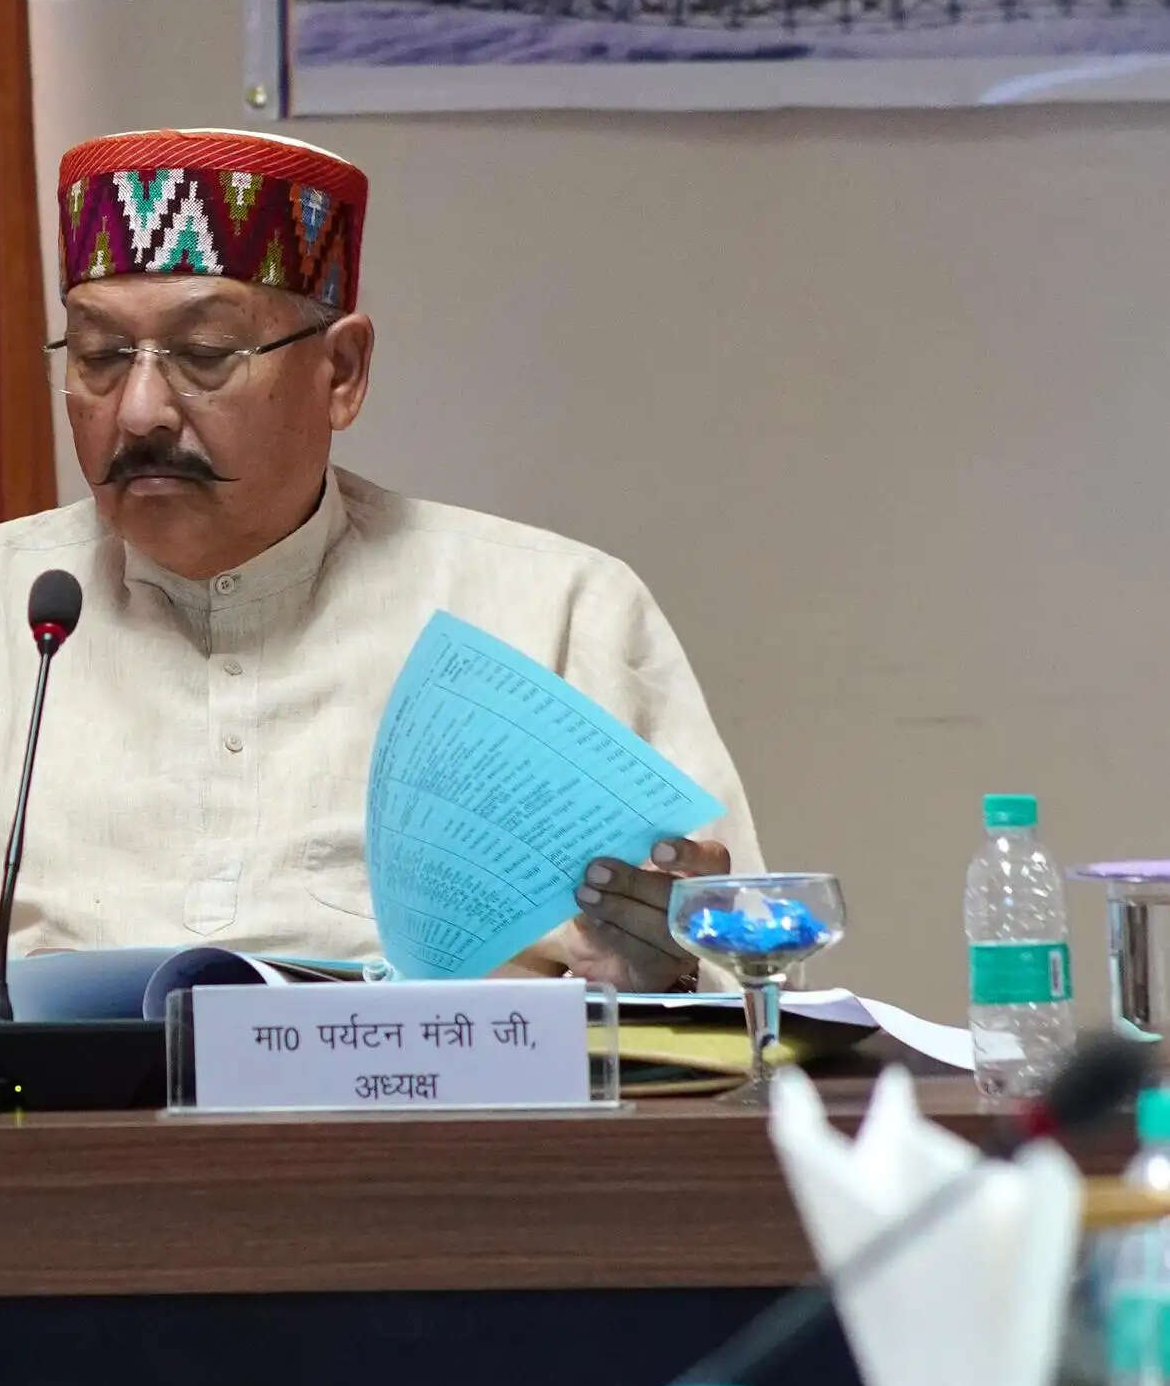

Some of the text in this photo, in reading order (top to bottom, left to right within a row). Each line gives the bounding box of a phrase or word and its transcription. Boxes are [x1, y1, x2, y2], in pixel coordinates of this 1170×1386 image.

[316, 1013, 404, 1049] पर्यटन
[419, 1013, 475, 1048] मंत्री
[490, 1011, 536, 1049] जी,
[355, 1074, 440, 1100] अध्यक्ष
